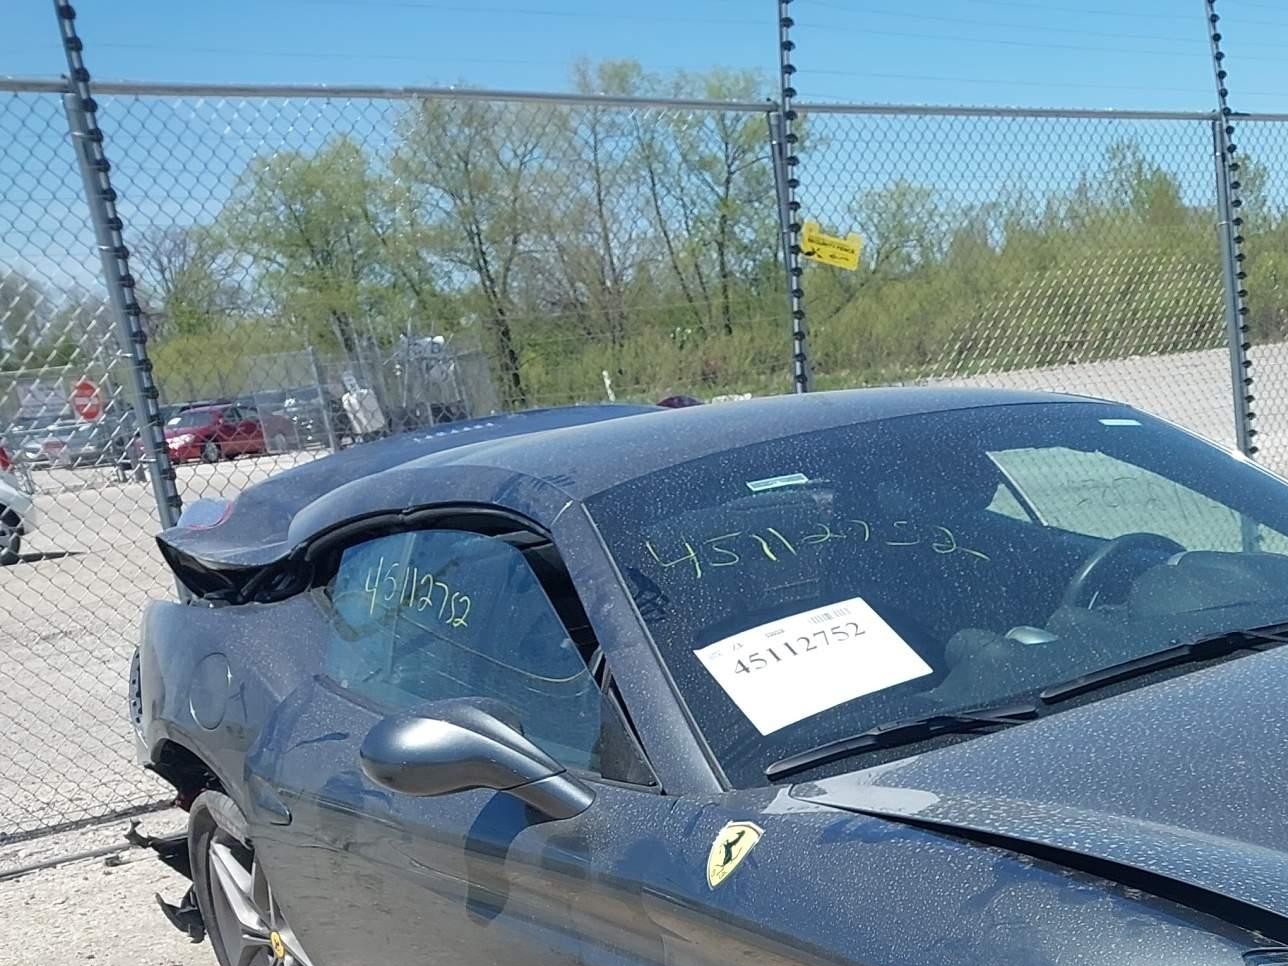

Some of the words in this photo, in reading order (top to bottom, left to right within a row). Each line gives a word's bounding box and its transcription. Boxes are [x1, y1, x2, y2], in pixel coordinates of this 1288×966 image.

[646, 519, 991, 578] 45112752
[365, 556, 471, 628] 45112752
[734, 622, 866, 674] 45112752
